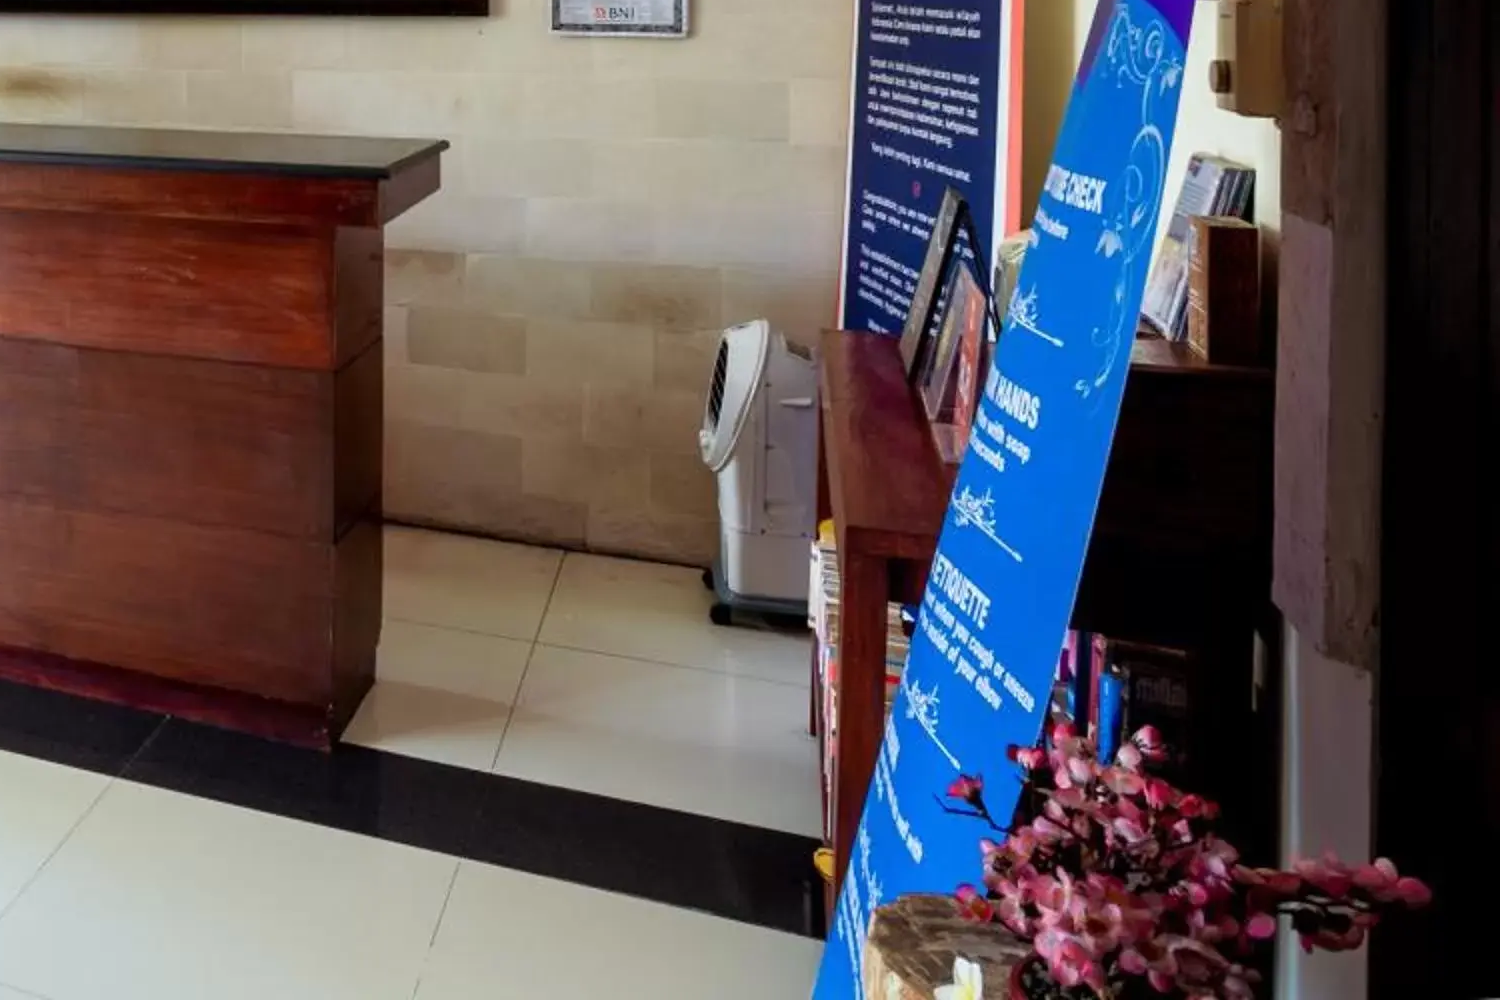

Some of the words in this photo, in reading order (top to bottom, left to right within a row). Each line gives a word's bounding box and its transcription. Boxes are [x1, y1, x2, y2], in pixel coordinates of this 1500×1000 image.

[608, 7, 636, 19] BNI
[1065, 172, 1108, 215] CHECK
[996, 375, 1041, 430] HANDS
[932, 553, 992, 631] ETIQUETTE
[968, 636, 994, 670] cough
